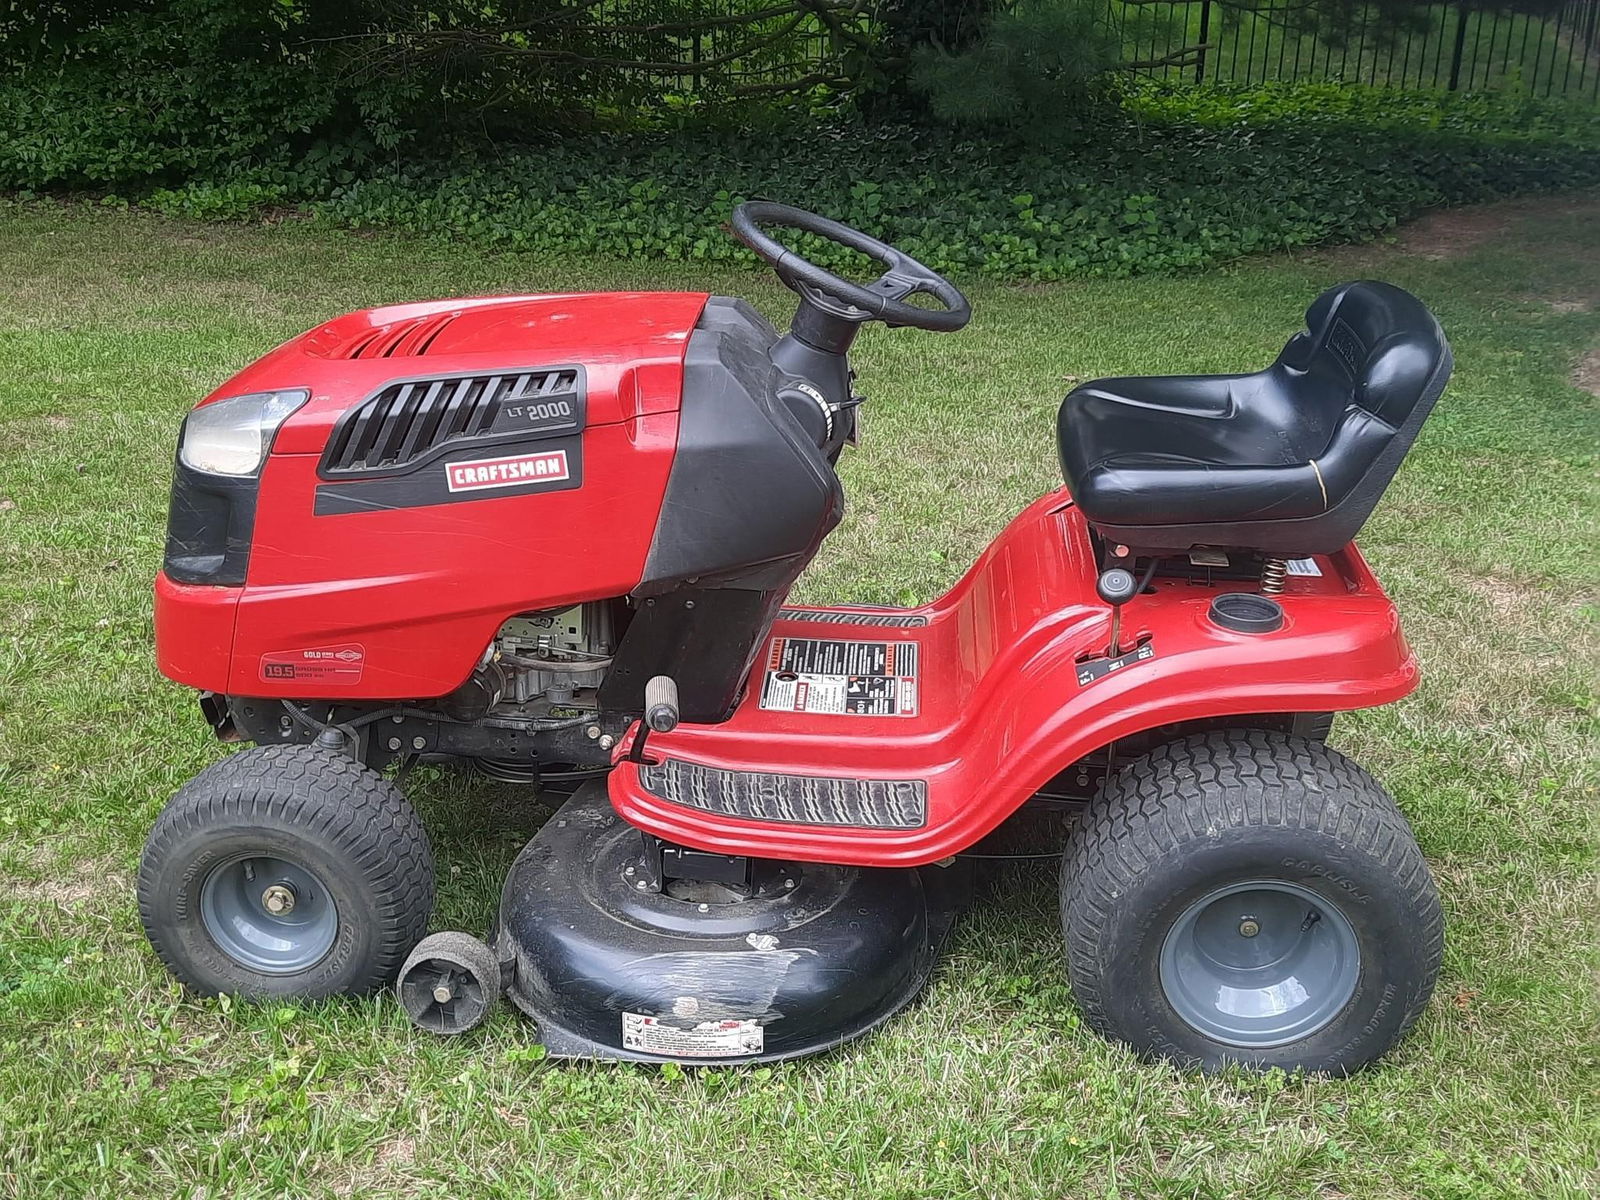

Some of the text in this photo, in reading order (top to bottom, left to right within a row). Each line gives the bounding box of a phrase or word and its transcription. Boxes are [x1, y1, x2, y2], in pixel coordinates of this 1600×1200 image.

[507, 401, 570, 421] LT 2000
[454, 458, 561, 485] CRAFTSMAN
[267, 666, 293, 677] 19.5
[1281, 857, 1373, 905] CARLISLE
